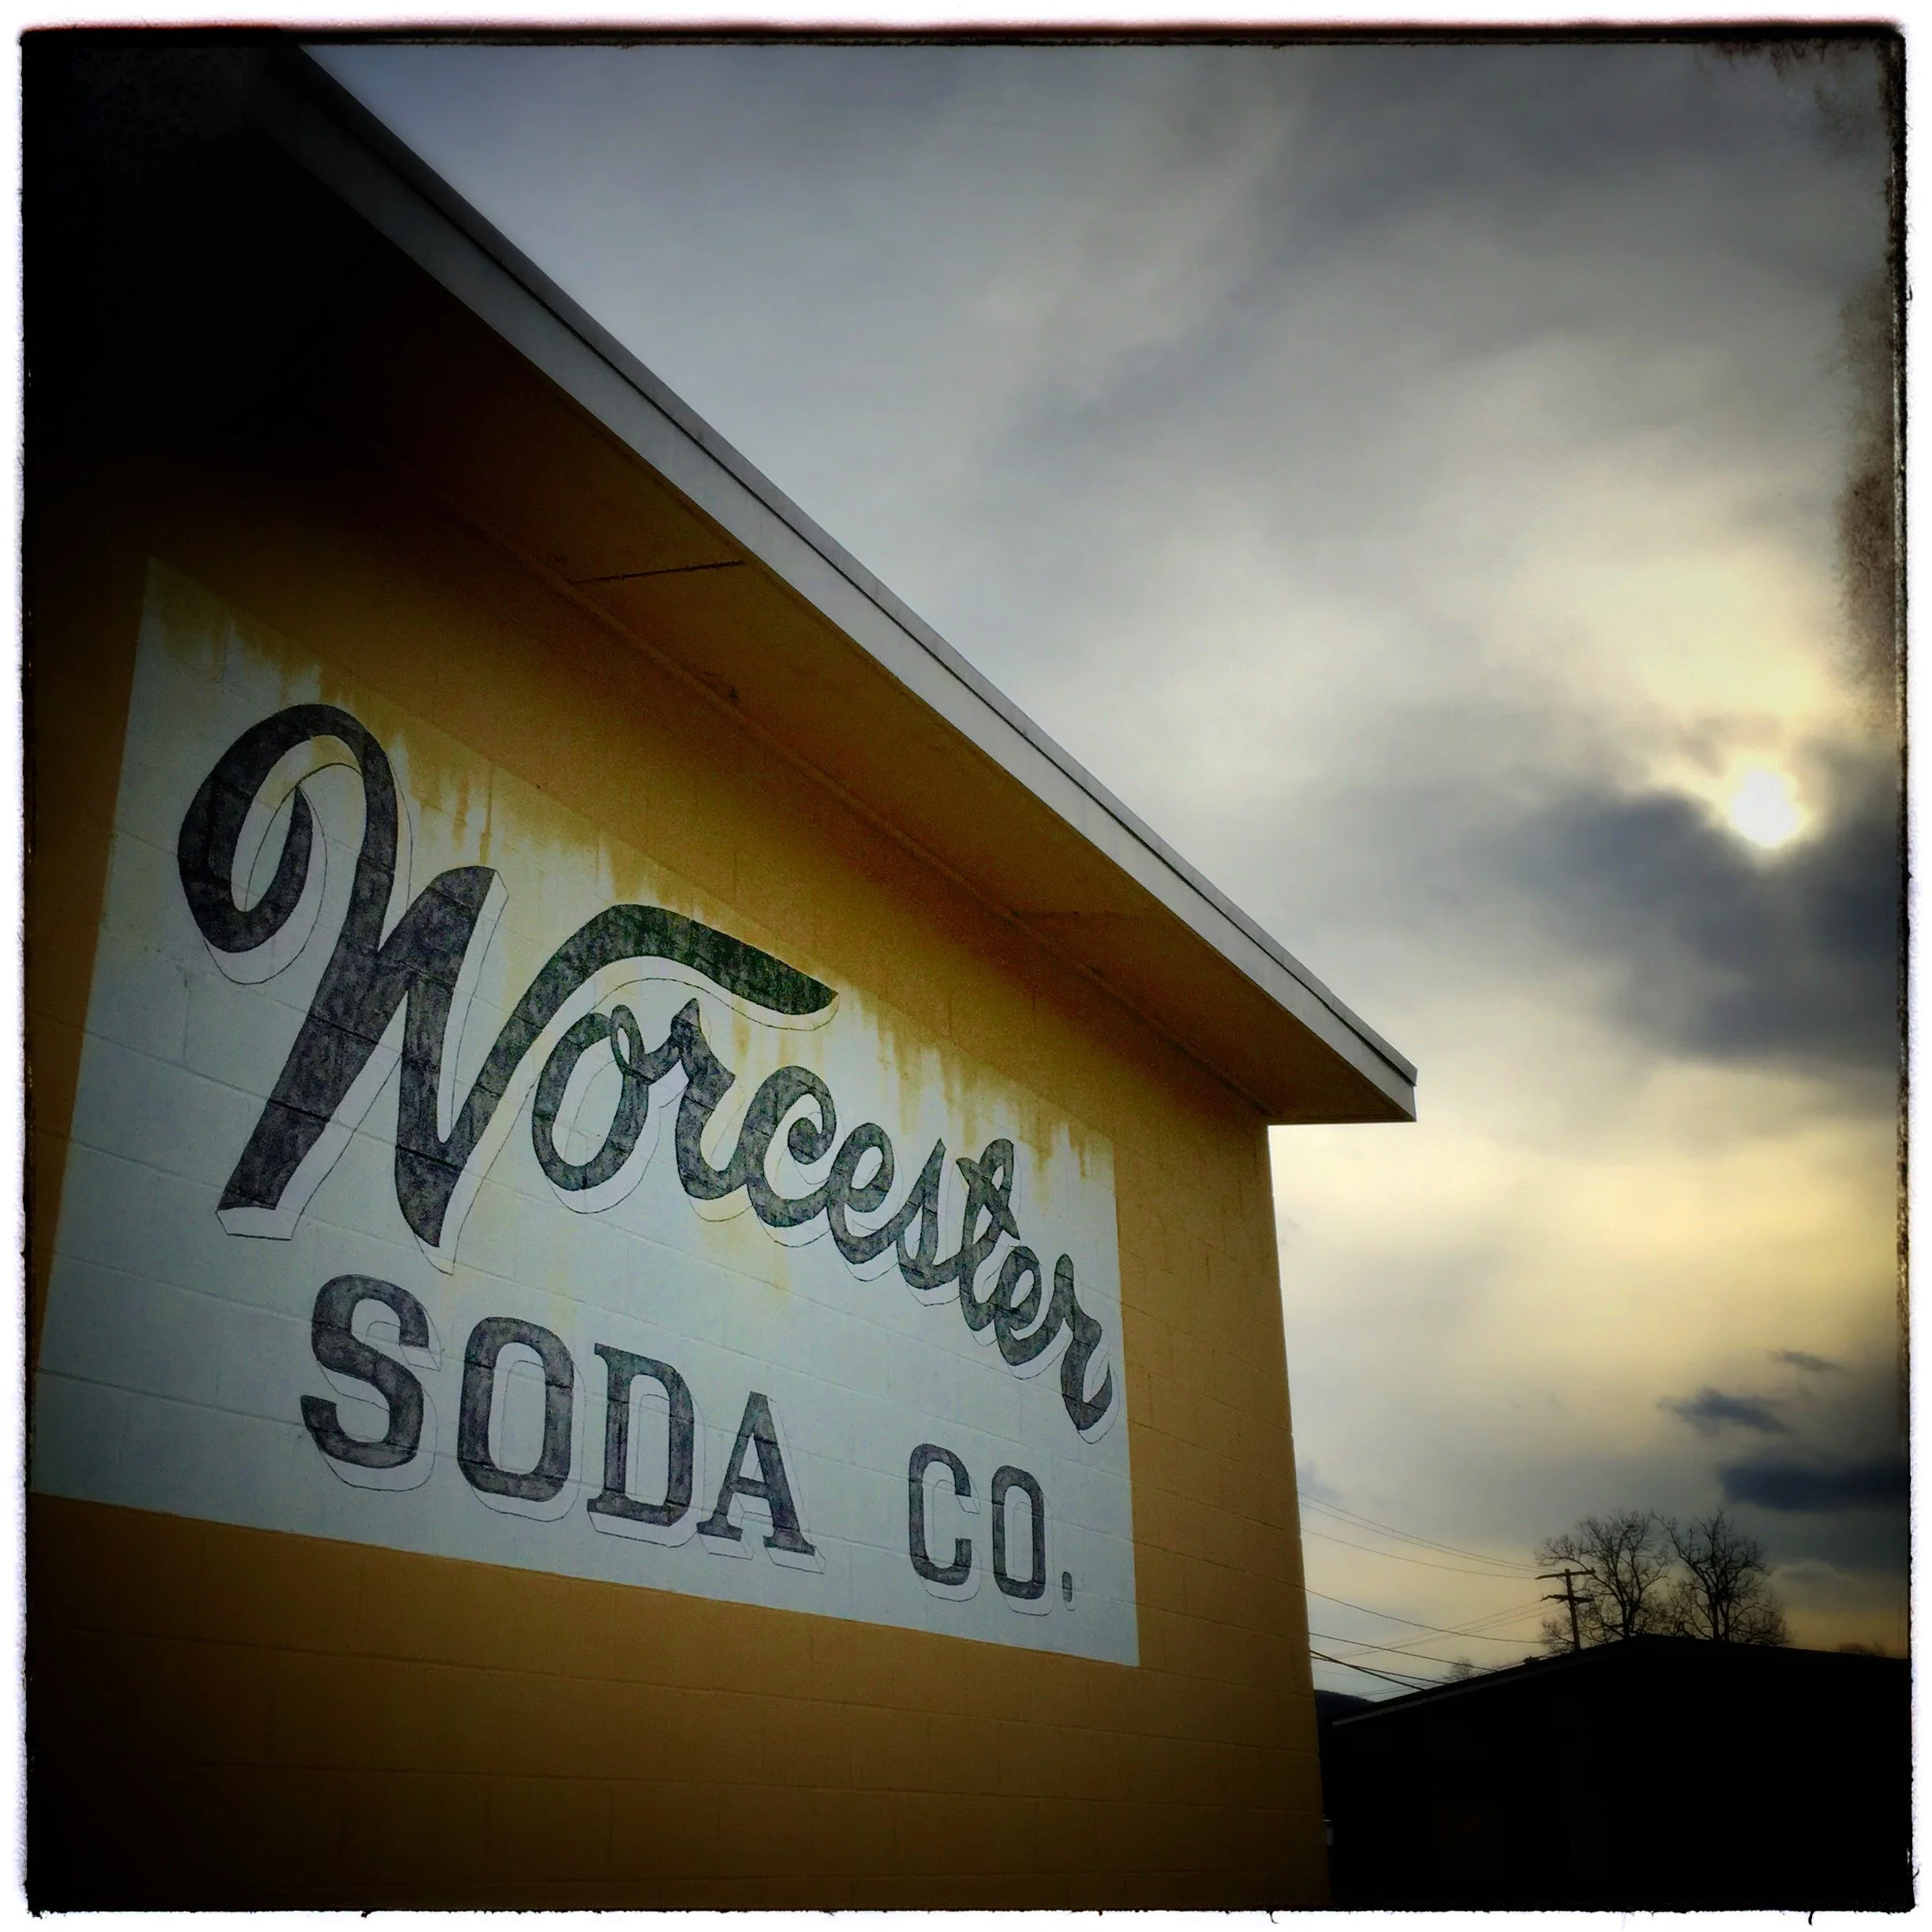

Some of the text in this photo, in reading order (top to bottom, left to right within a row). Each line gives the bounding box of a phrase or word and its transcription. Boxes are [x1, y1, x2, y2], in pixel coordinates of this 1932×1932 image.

[178, 702, 1113, 1431] Worcester
[300, 1274, 1073, 1600] SODA CO.
